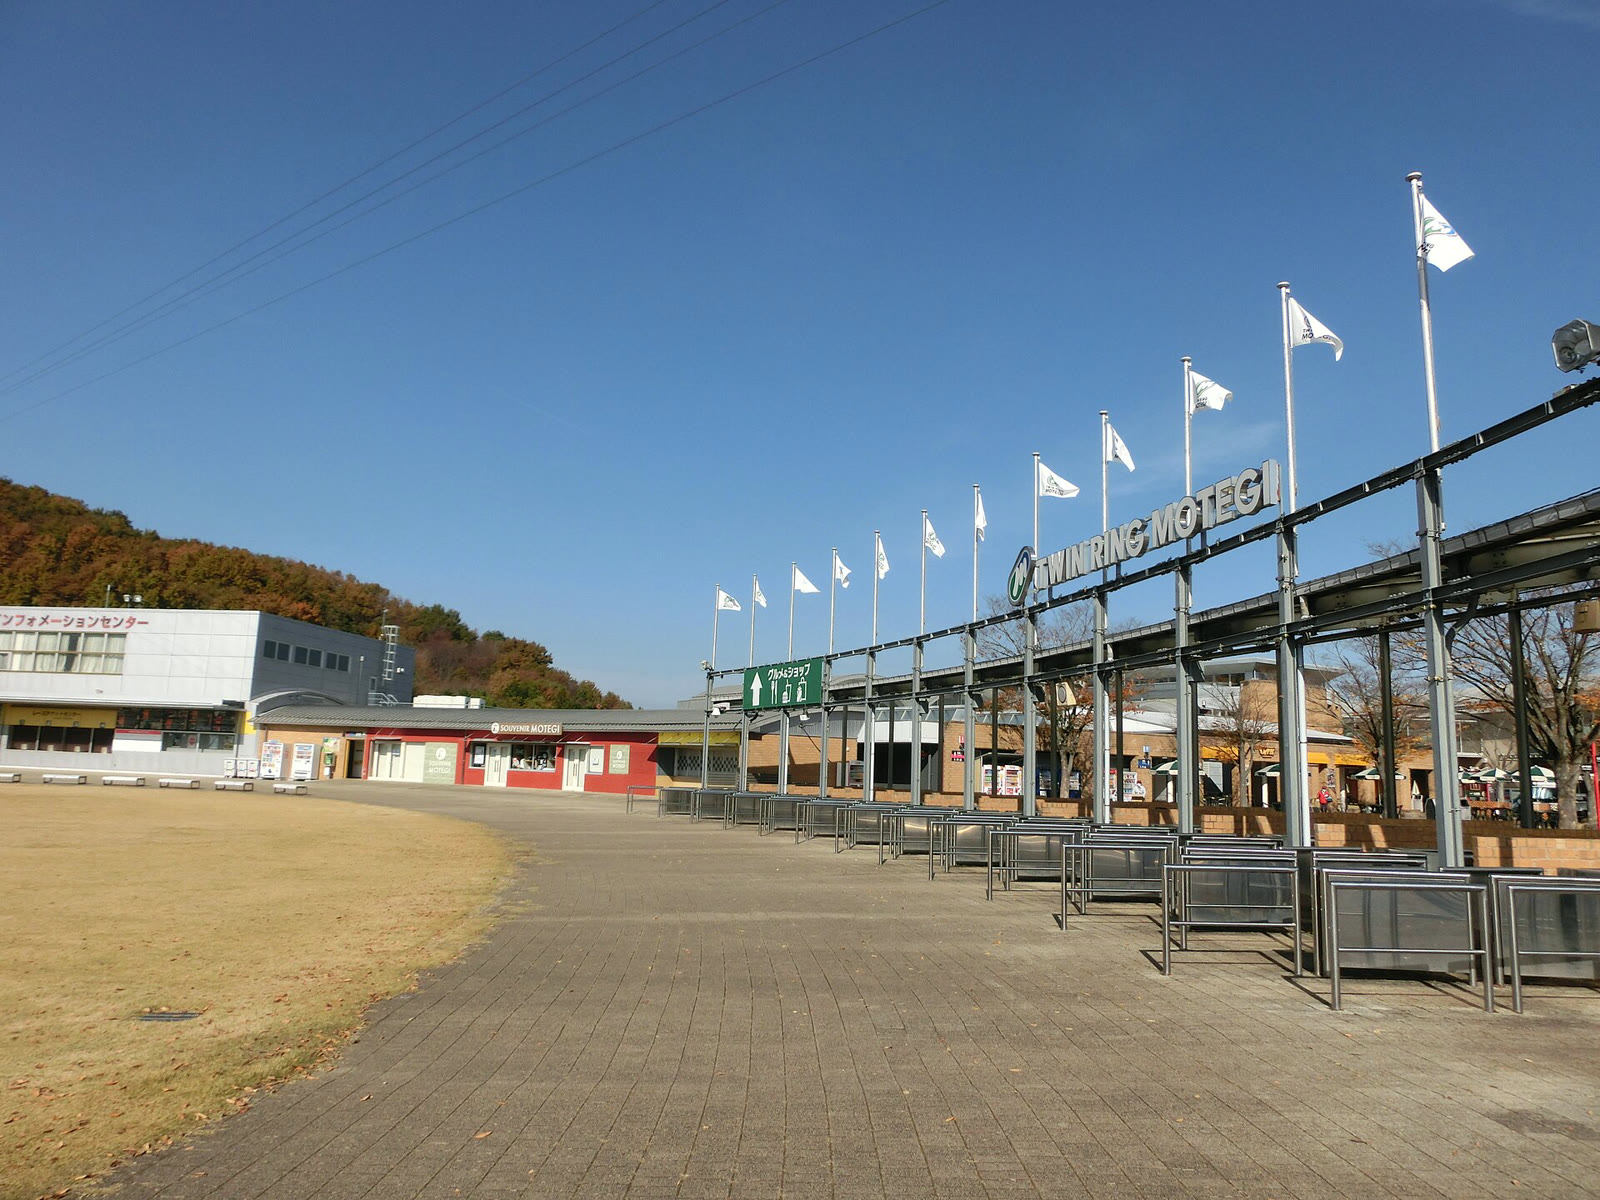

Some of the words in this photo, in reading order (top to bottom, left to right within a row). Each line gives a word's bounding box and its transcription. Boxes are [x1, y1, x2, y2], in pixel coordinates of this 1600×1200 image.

[1036, 541, 1091, 591] TWIN
[1090, 518, 1149, 568] RING
[1151, 459, 1279, 549] MOTEGI
[0, 614, 149, 630] ンフォメーションセンター
[500, 724, 530, 732] SOUVENIR
[530, 724, 560, 734] MOTEGI
